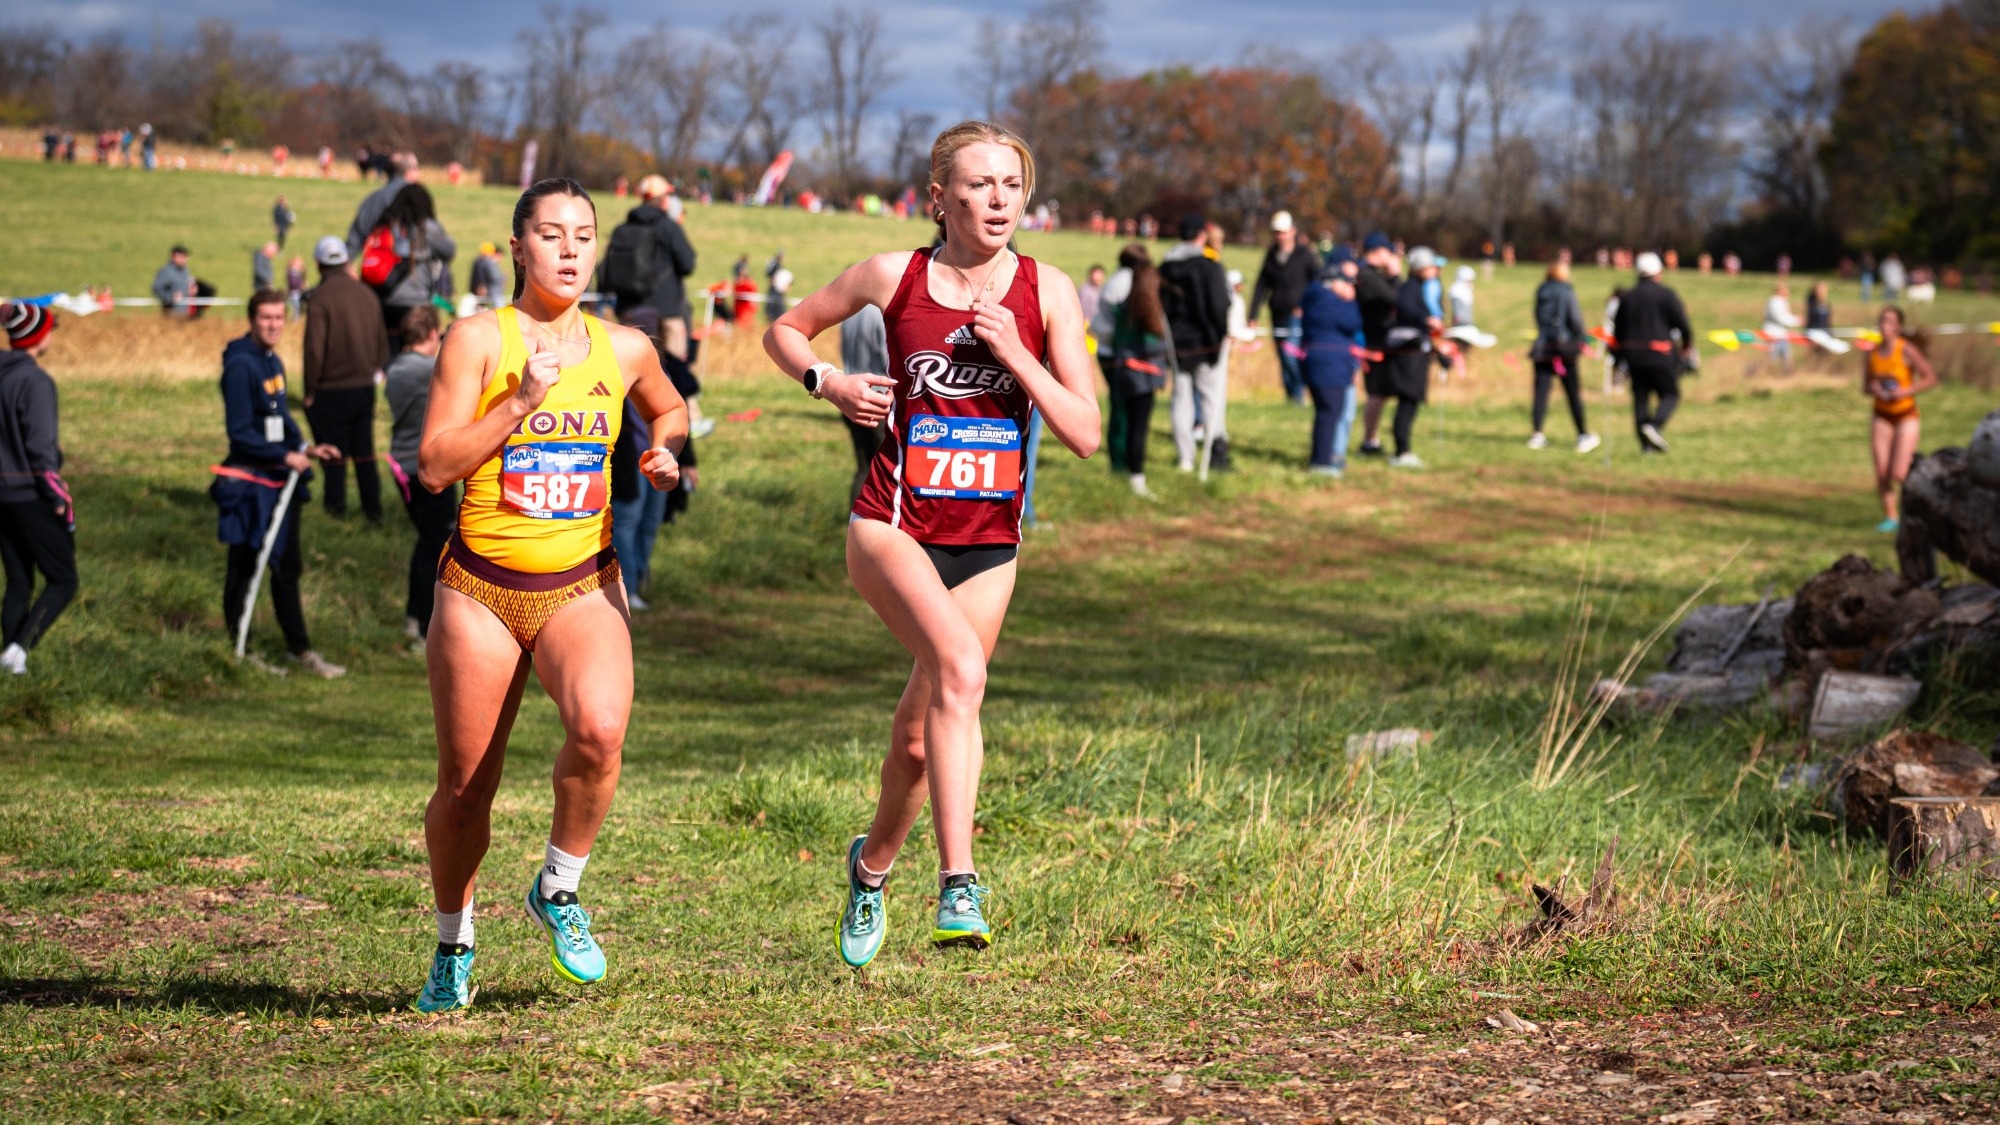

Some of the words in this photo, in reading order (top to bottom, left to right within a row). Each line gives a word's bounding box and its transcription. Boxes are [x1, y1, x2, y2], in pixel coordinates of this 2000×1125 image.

[944, 337, 977, 346] adidas
[904, 350, 1017, 399] RIDER
[912, 423, 948, 442] MAAC
[952, 429, 979, 440] CROSS
[979, 430, 1018, 441] COUNTRY
[508, 449, 541, 469] MAAC
[926, 450, 997, 489] 761
[523, 474, 591, 511] 587
